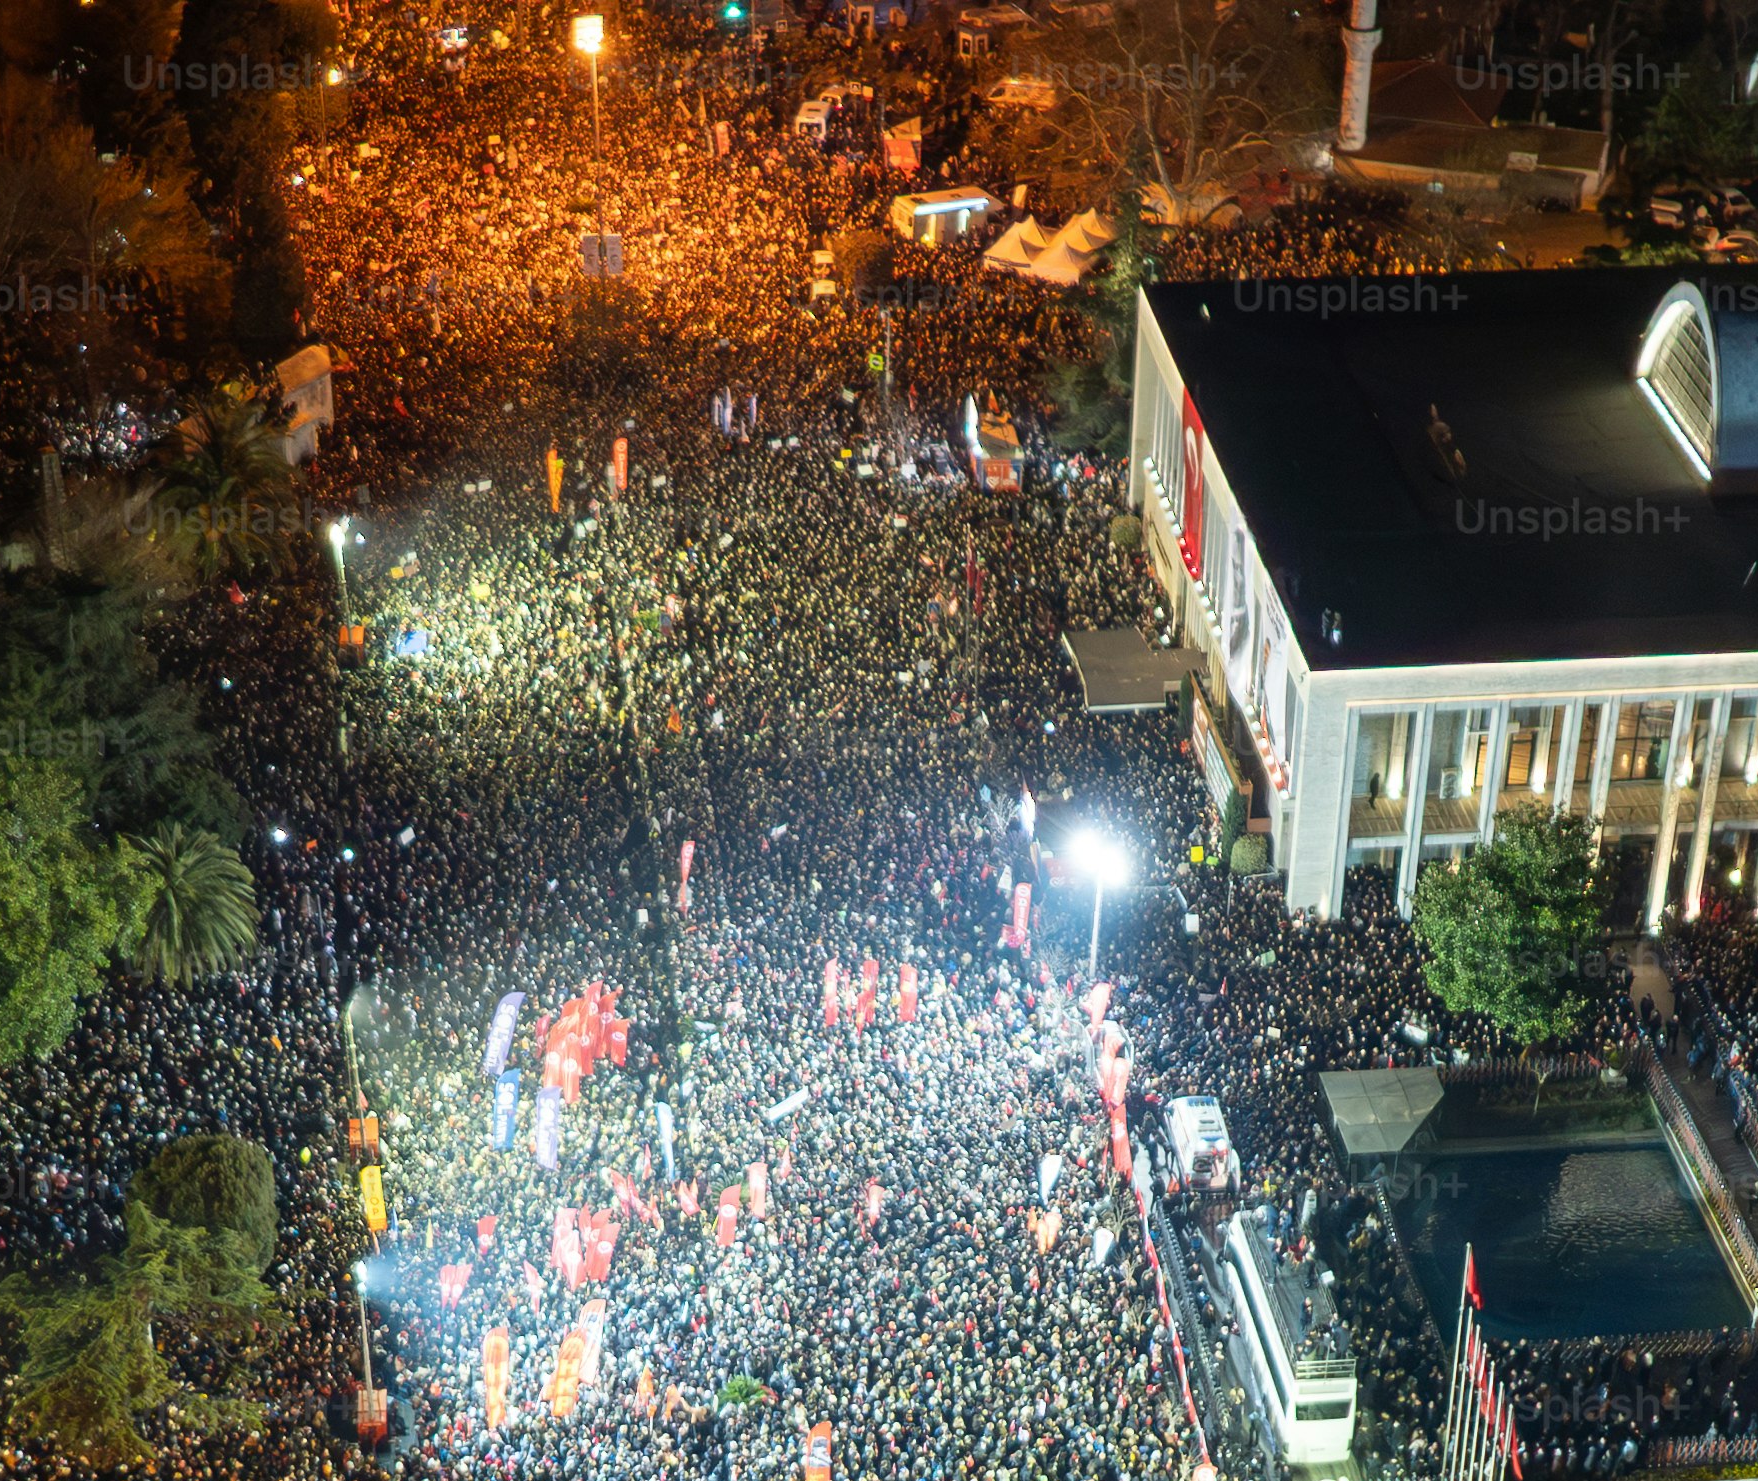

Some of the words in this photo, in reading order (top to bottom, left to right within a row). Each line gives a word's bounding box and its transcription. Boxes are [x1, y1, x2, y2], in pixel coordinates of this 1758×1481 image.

[493, 1002, 517, 1041] SOL
[496, 1081, 515, 1115] SOL
[553, 1358, 580, 1415] HKP
